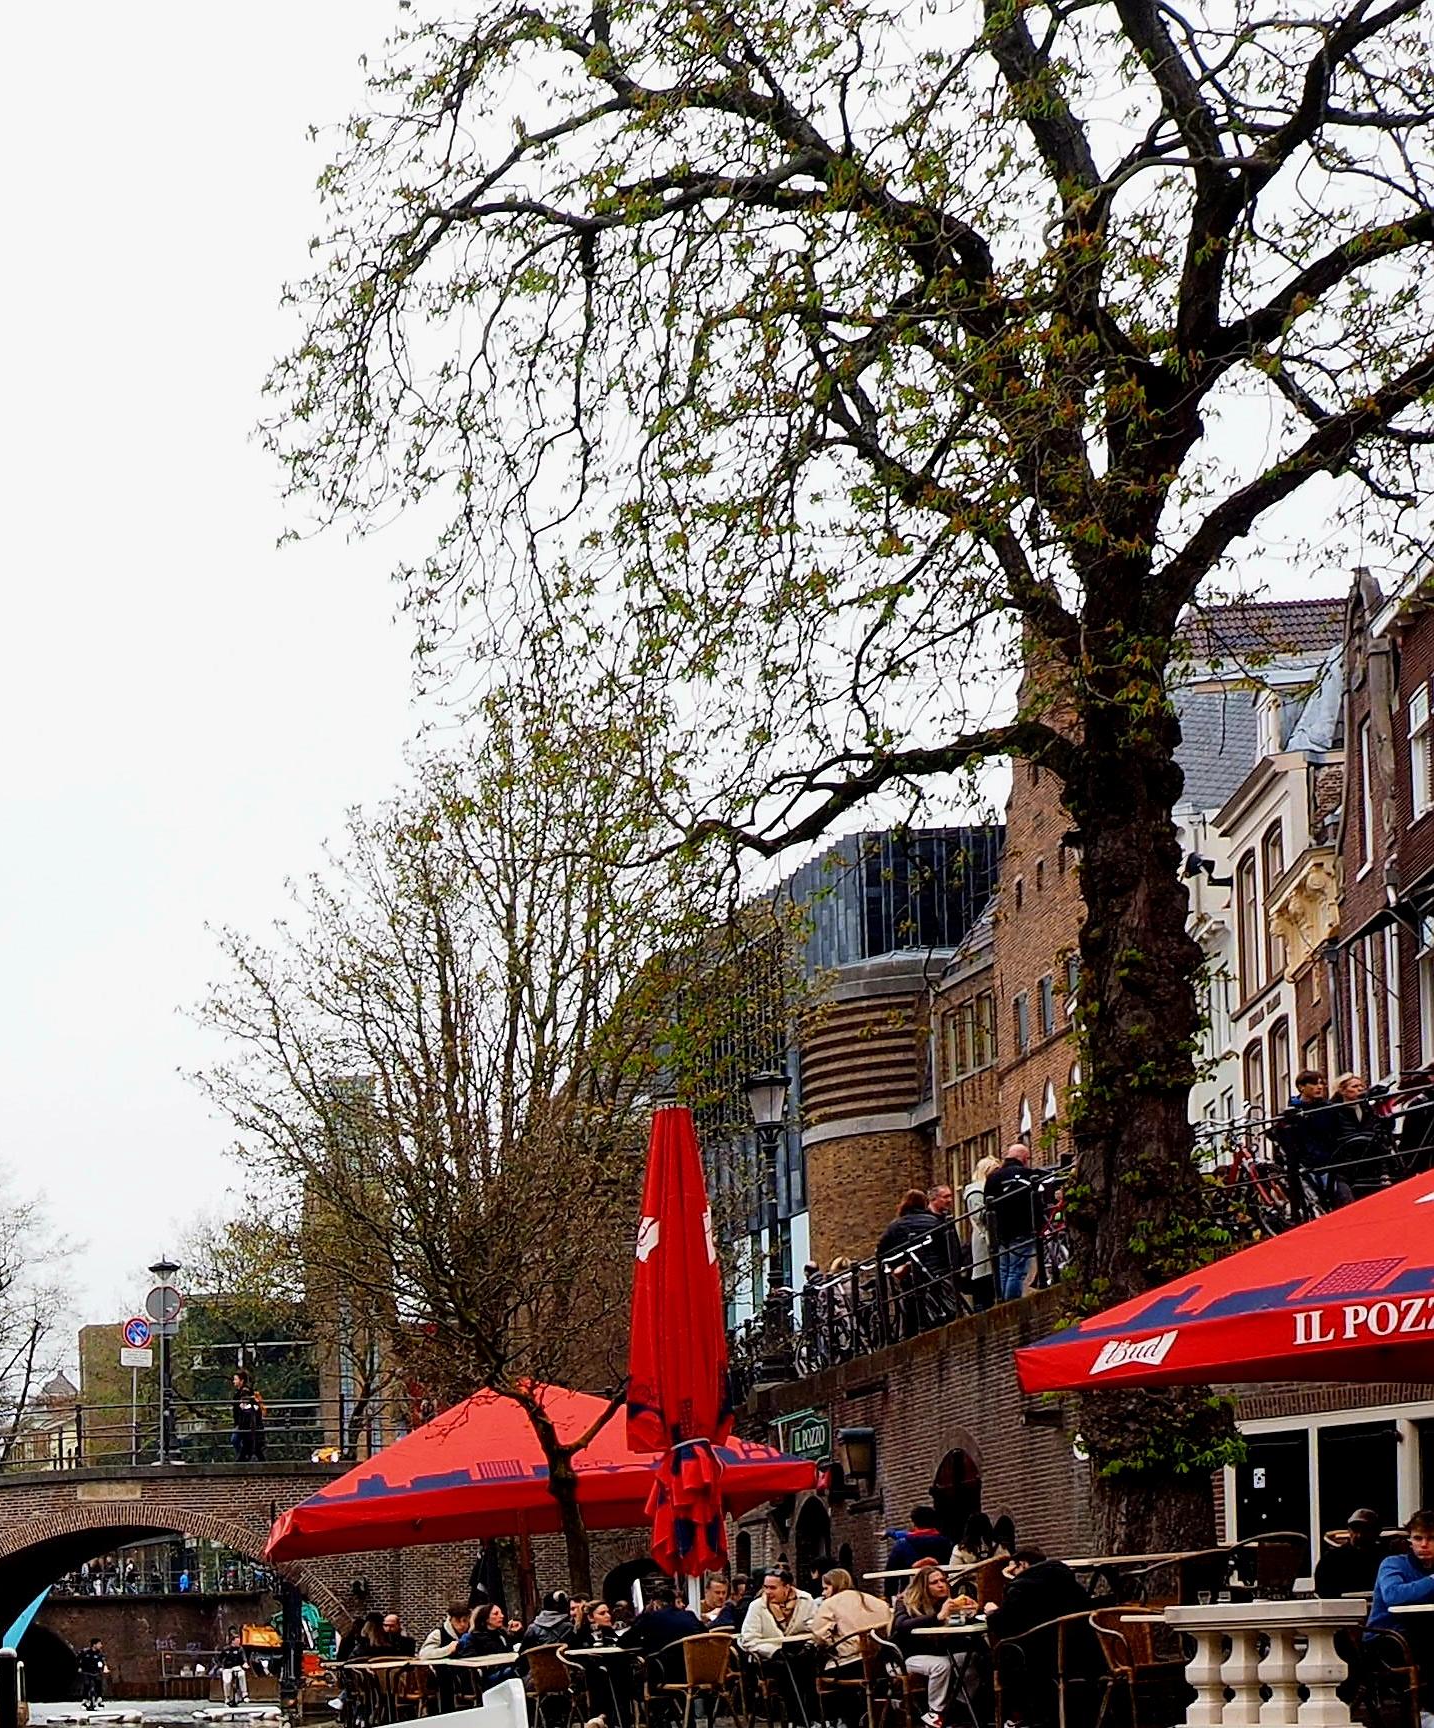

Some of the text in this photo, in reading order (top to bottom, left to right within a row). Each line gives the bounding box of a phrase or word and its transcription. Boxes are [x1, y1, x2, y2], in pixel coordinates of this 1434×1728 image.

[1292, 1297, 1434, 1345] IL POZ
[802, 1424, 826, 1451] POZZO
